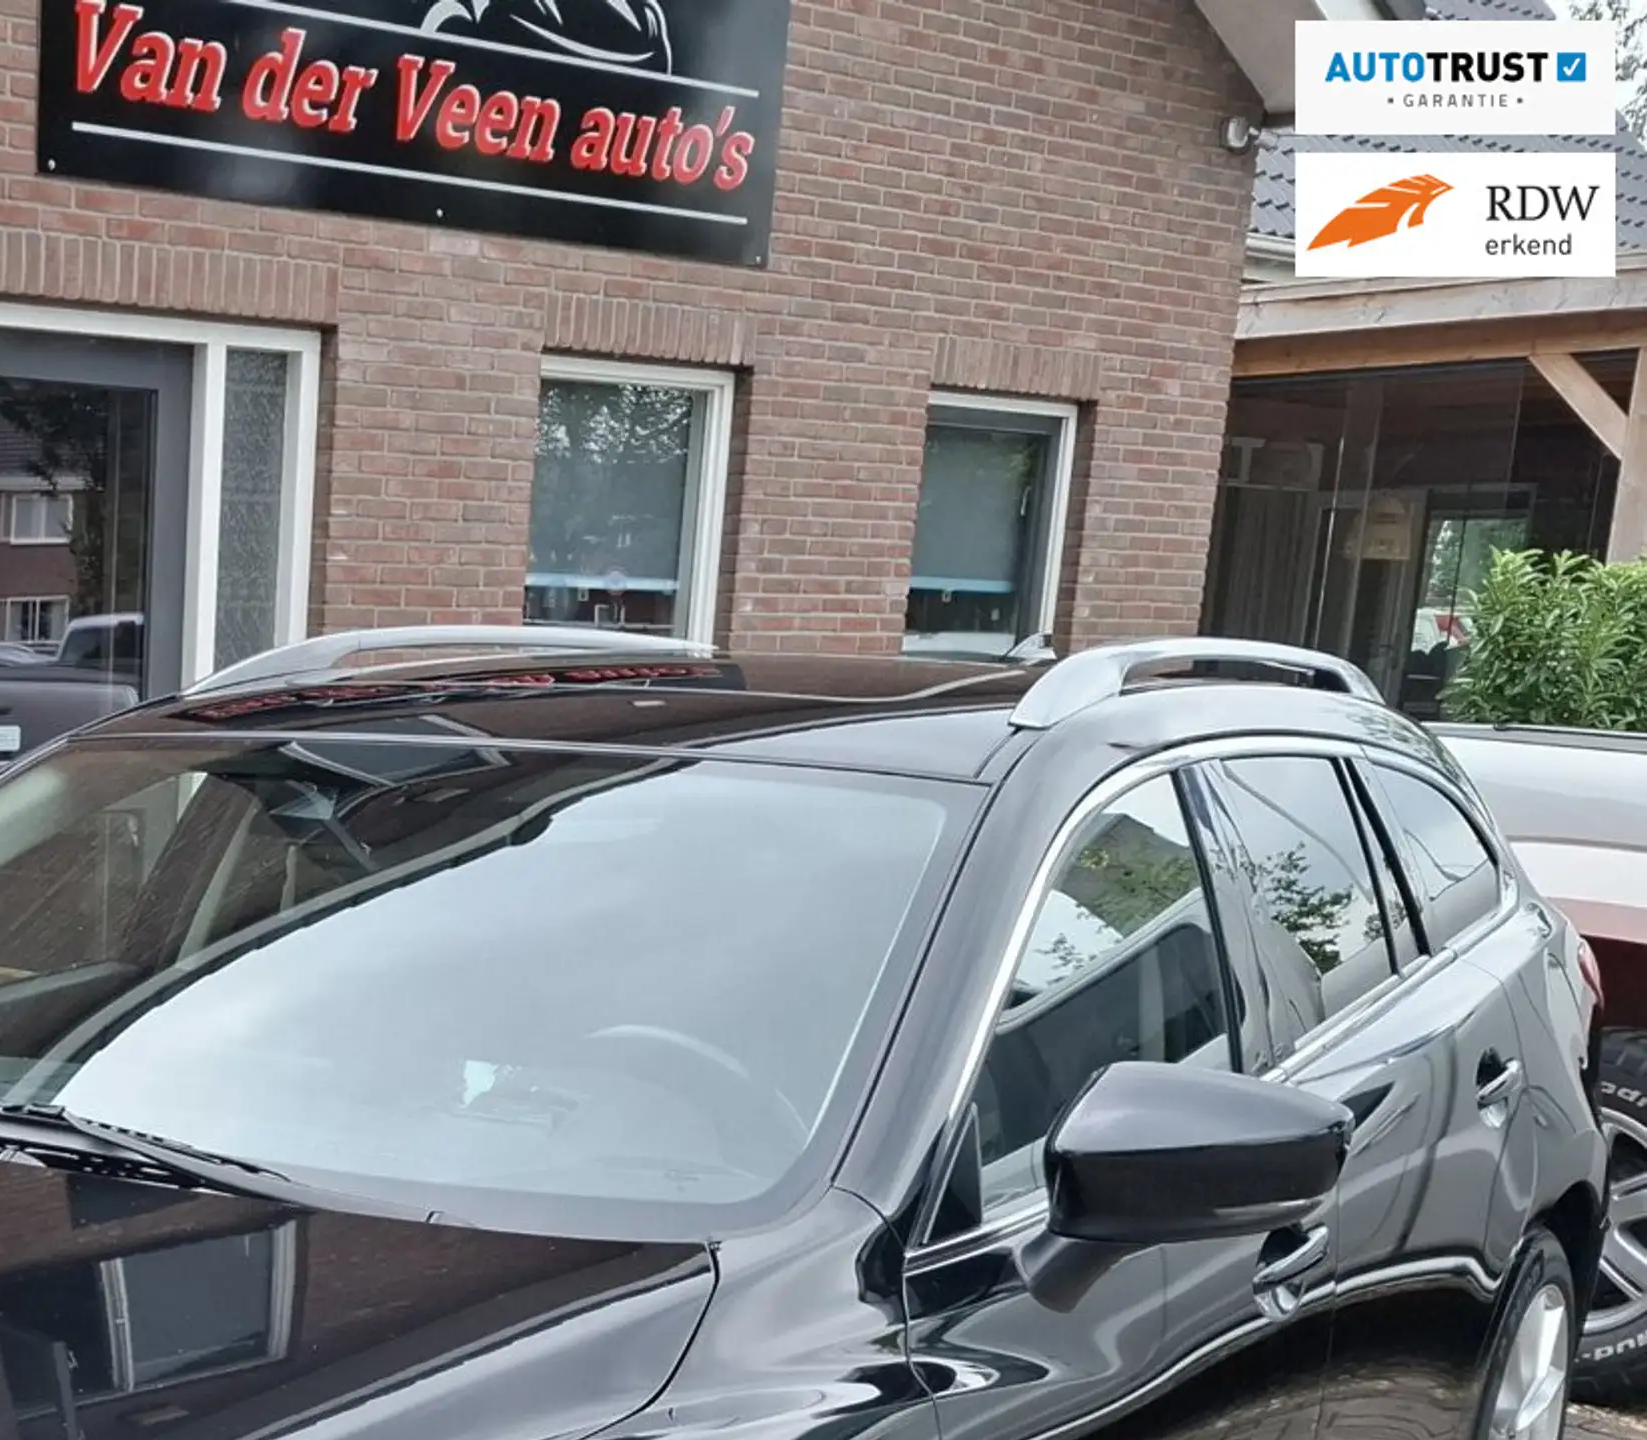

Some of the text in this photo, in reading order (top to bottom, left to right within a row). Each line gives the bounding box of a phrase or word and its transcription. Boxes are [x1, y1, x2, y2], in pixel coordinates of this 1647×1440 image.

[73, 1, 754, 191] Van der Veen auto's
